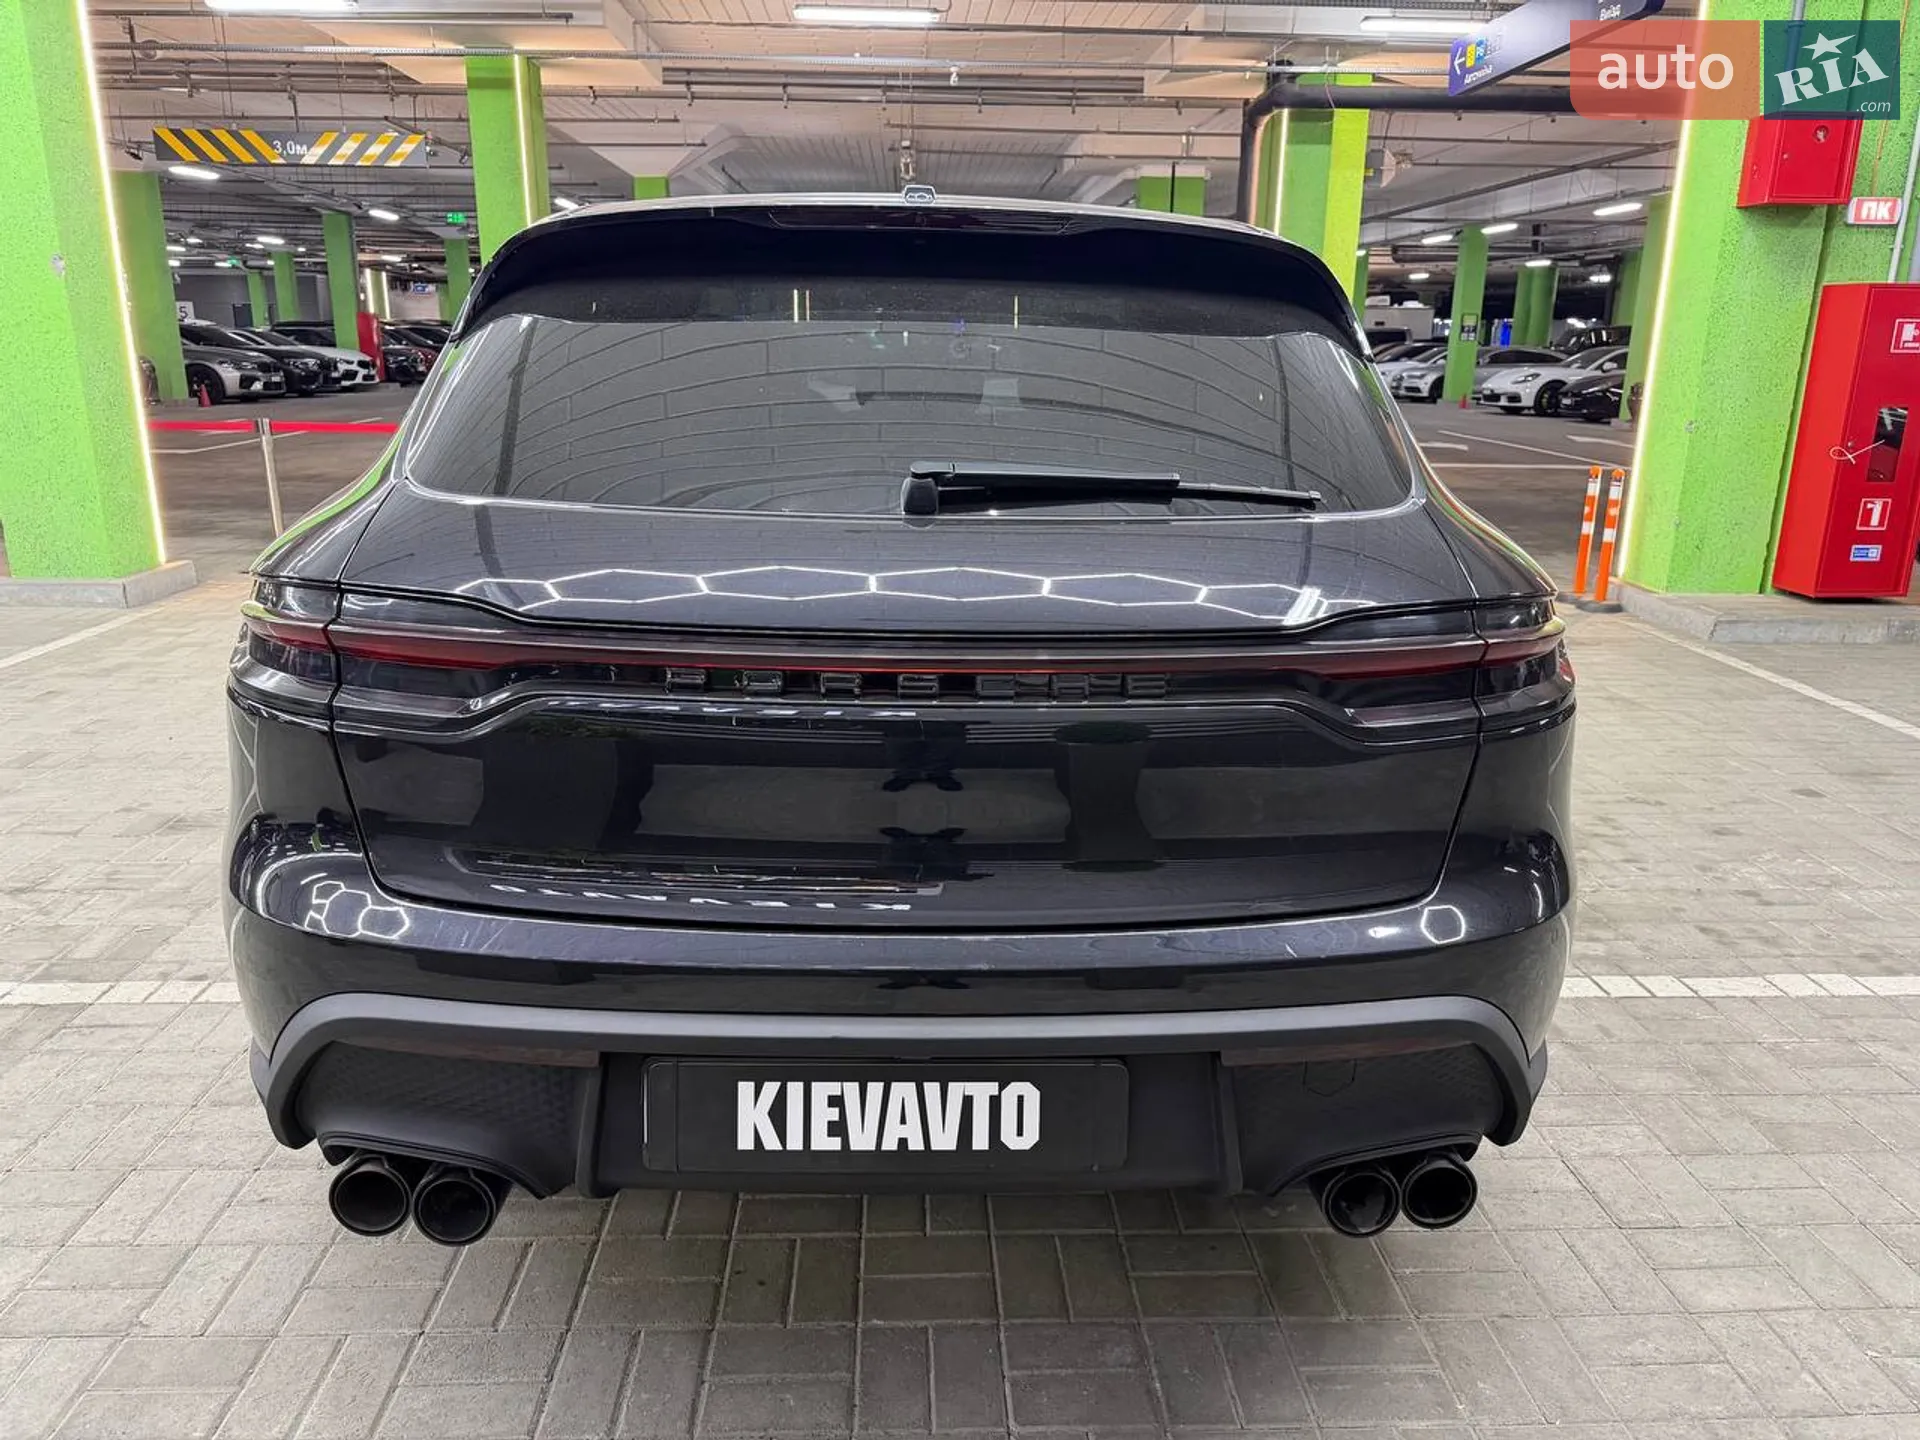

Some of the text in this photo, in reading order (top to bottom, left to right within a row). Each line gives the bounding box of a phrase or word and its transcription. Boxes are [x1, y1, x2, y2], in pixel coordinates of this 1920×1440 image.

[1861, 199, 1892, 221] ПК
[665, 667, 1166, 699] PORSCHE
[736, 1081, 1041, 1151] KIEVAVTO
